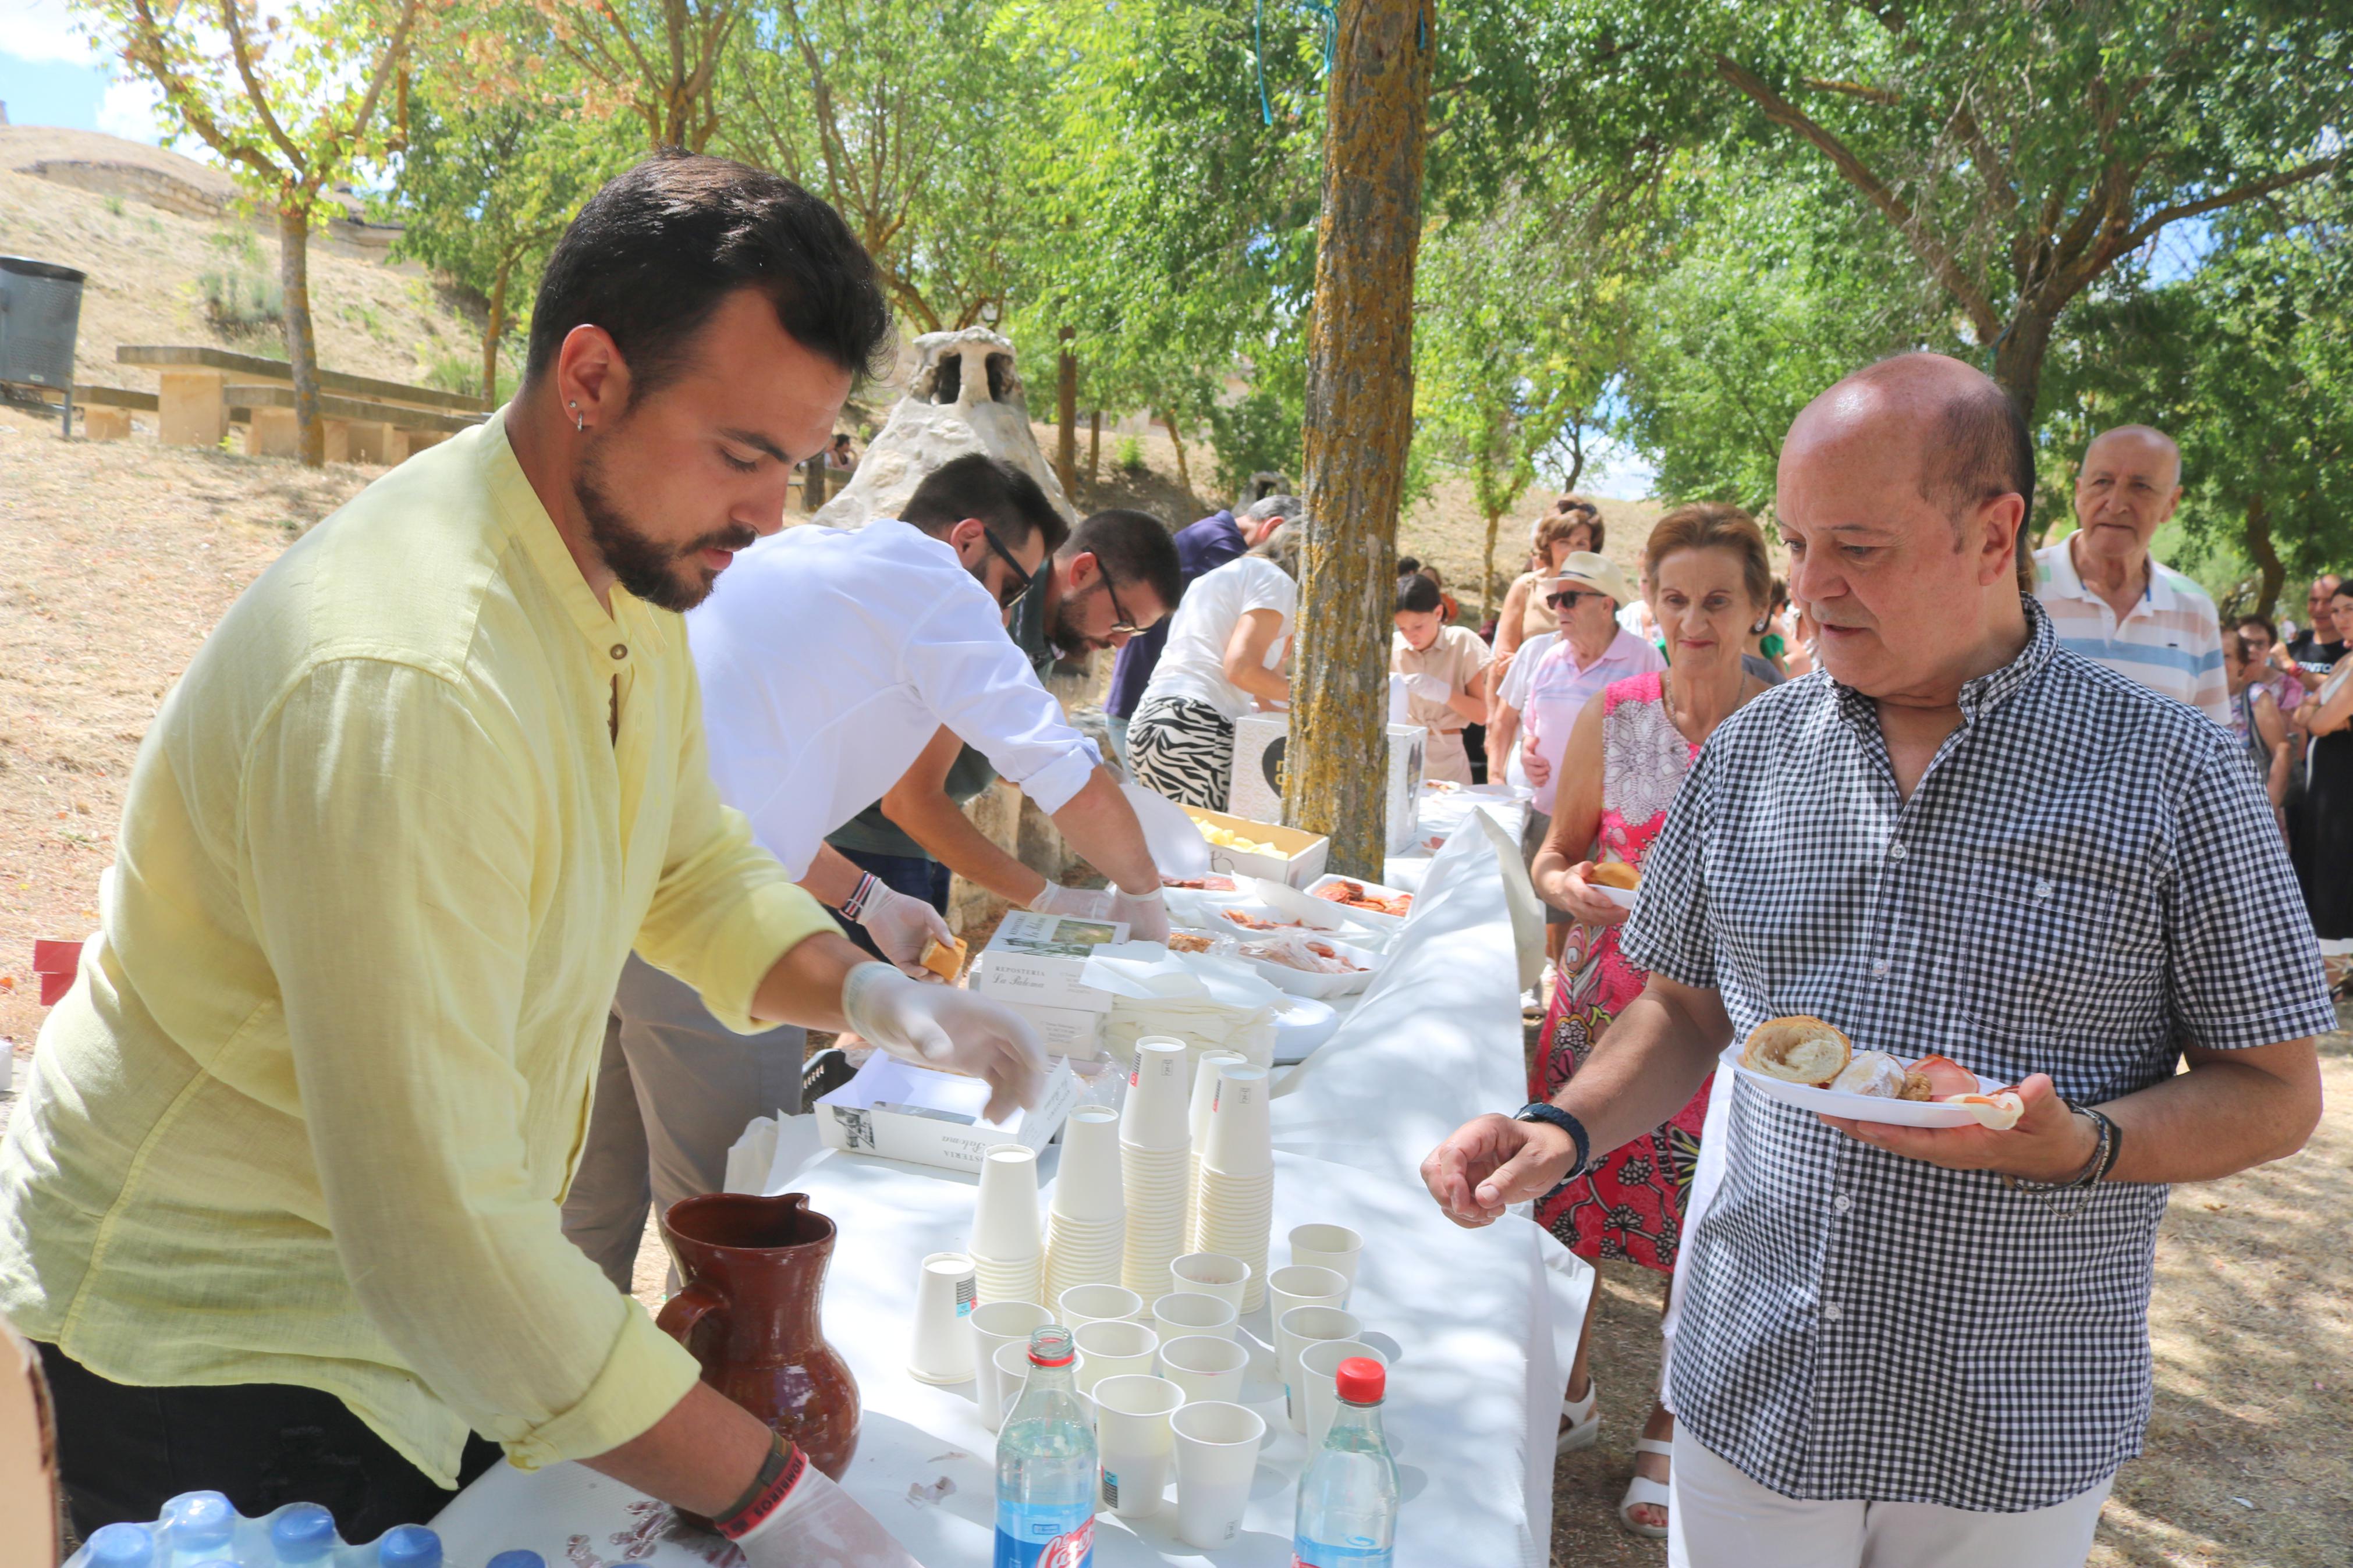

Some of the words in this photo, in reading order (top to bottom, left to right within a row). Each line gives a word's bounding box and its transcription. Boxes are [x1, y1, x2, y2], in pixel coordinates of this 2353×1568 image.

[995, 965, 1046, 977] REPOSTERIA
[992, 973, 1007, 984] La
[1009, 975, 1045, 989] Paloma
[941, 1135, 986, 1154] Paloma
[943, 1150, 984, 1162] STERIA
[754, 1456, 804, 1517] BOMBEROS
